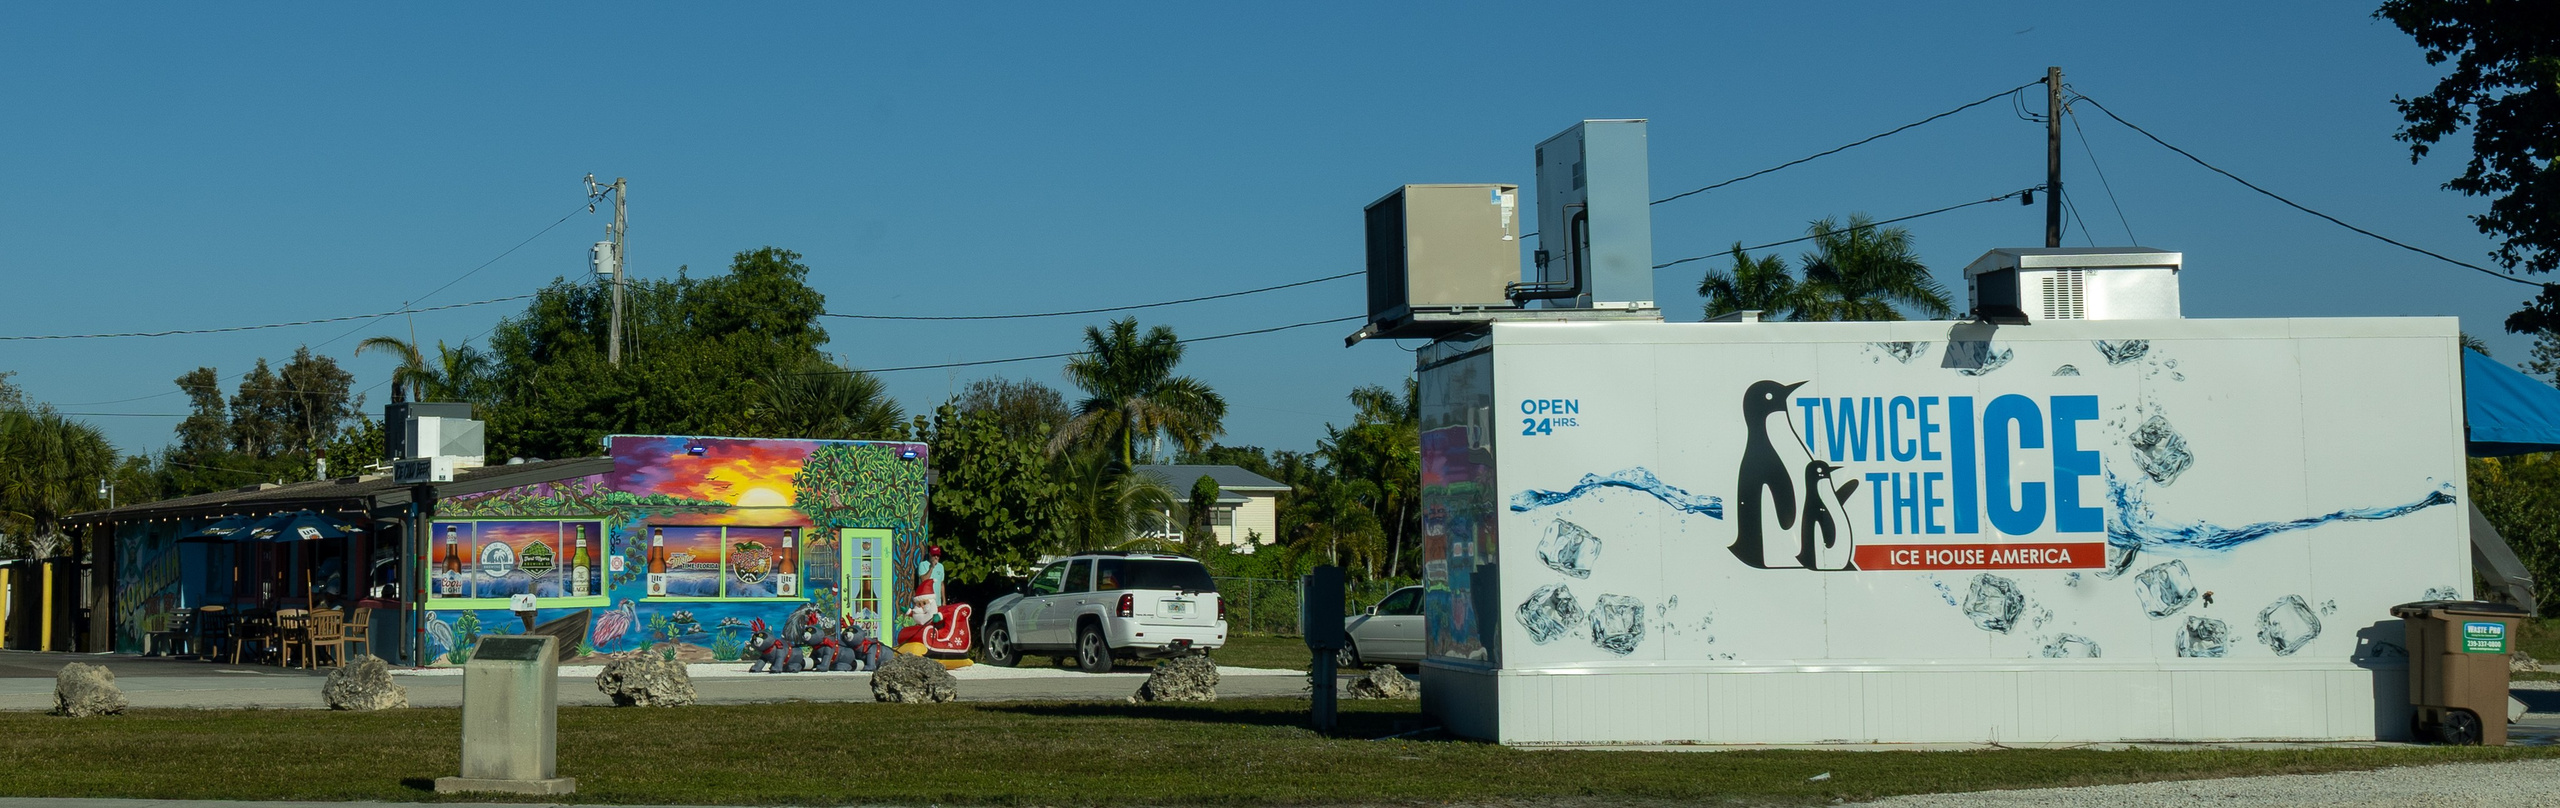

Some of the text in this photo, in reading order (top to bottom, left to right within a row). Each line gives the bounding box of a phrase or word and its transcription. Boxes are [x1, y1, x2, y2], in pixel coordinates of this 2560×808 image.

[1521, 399, 1578, 415] OPEN
[1522, 418, 1579, 436] 24 HRS.
[1796, 396, 1942, 462] TWICE
[1948, 394, 2104, 536] ICE
[1865, 472, 1946, 535] THE
[1891, 549, 2071, 566] ICE HOUSE AMERICA
